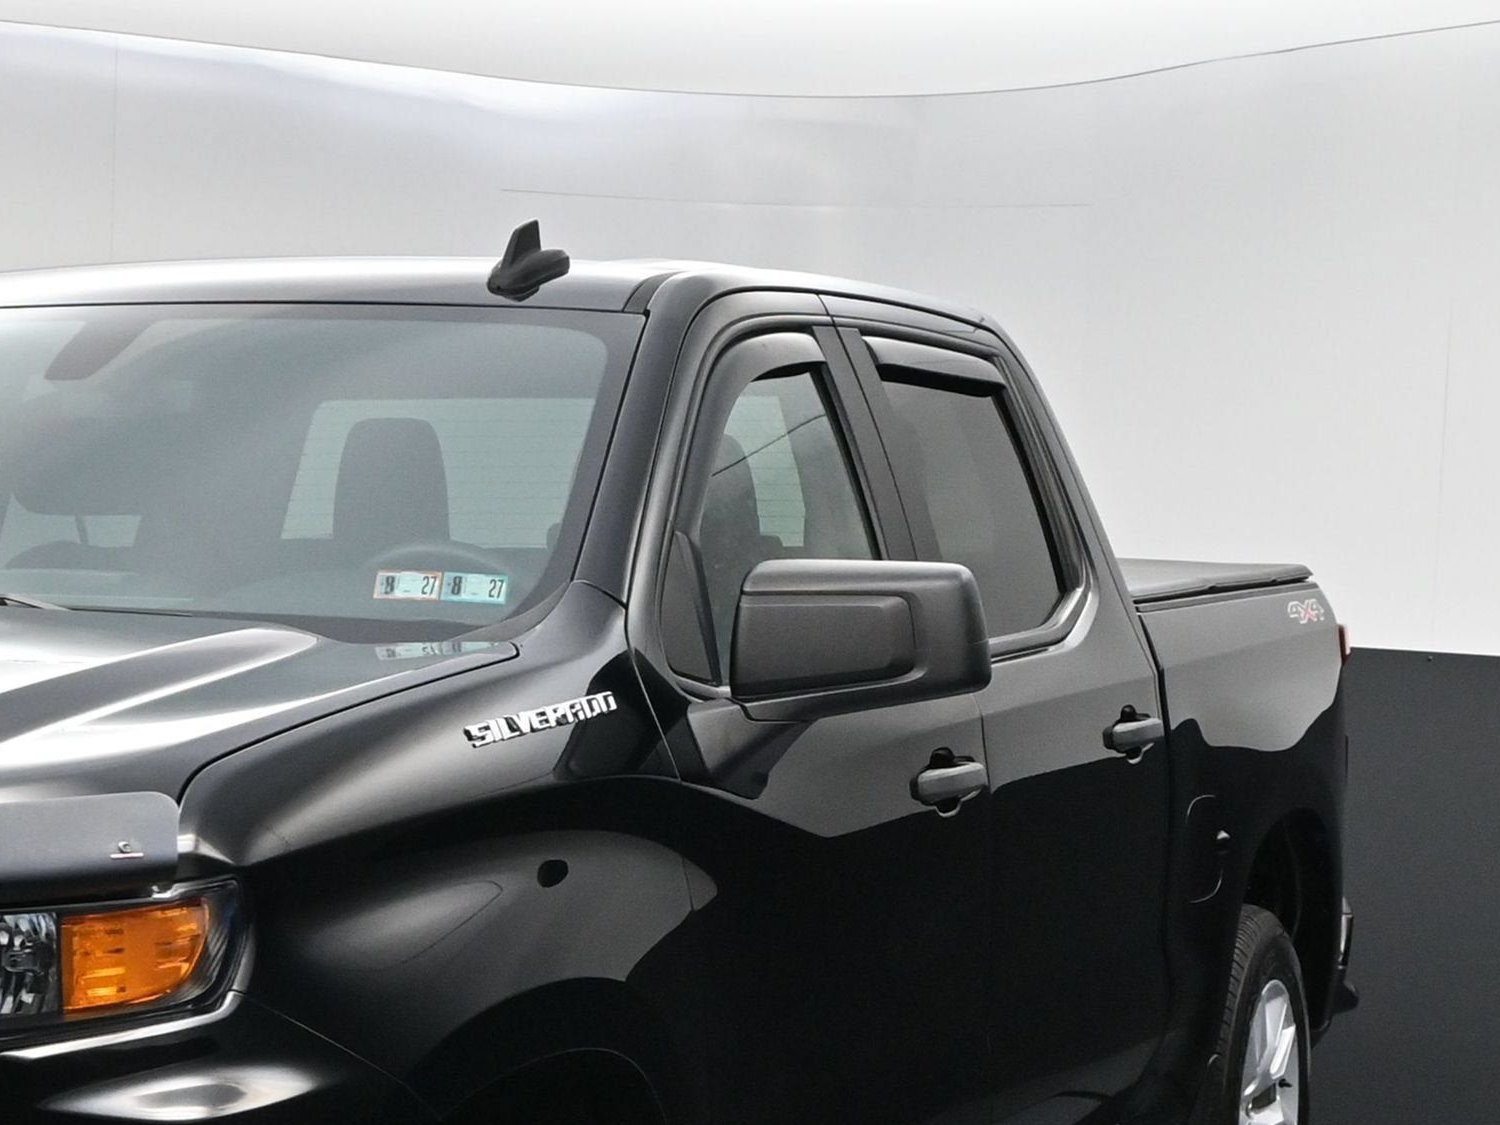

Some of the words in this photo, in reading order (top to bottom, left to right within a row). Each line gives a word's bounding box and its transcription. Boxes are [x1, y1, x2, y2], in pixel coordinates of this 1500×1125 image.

[421, 575, 437, 597] 27
[451, 575, 463, 596] 8
[488, 578, 504, 599] 27
[463, 690, 618, 748] SILVERADO
